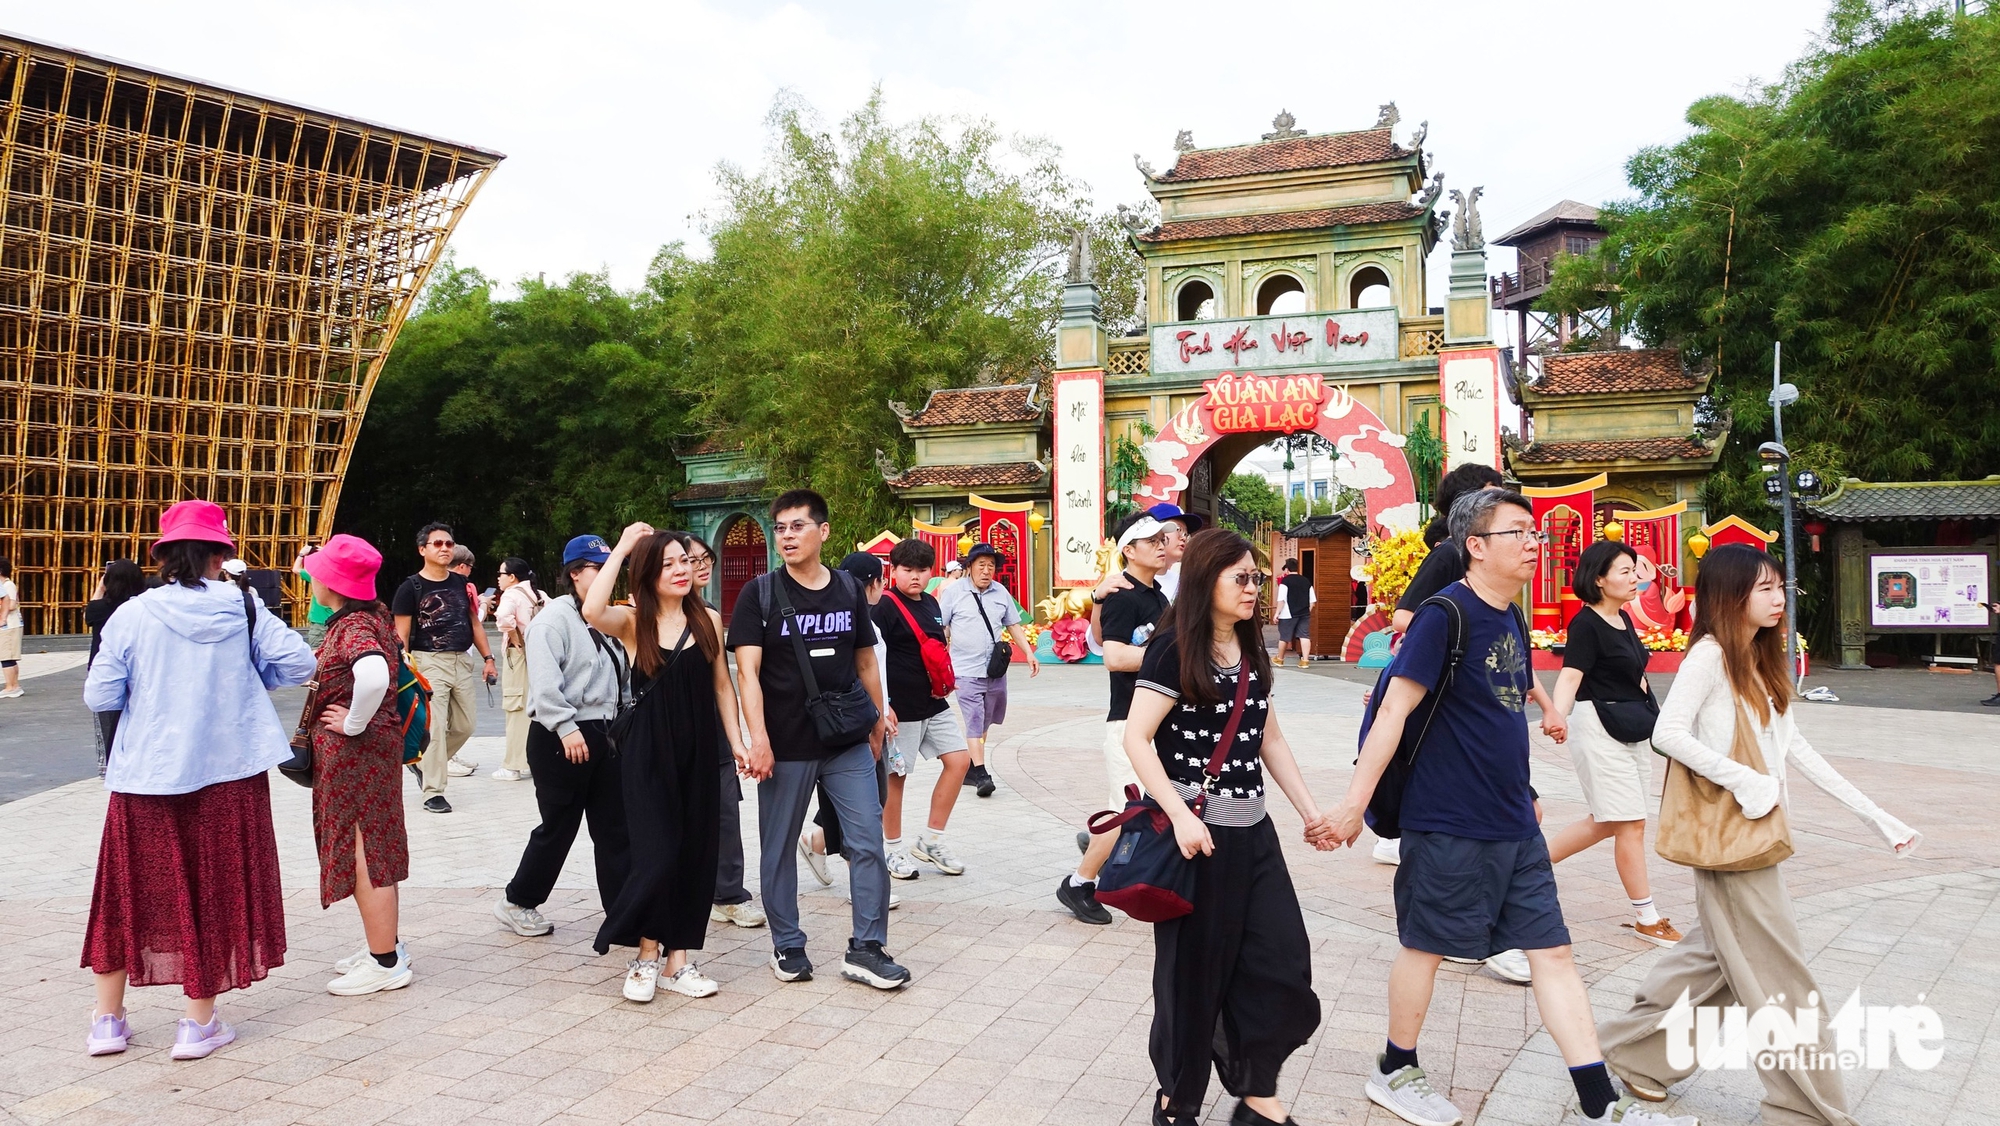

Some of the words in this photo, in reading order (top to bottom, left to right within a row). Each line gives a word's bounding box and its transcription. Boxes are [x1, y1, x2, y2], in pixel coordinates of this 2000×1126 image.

[1271, 321, 1312, 354] Việt
[1326, 318, 1369, 351] Nam
[1205, 374, 1280, 406] XUÂN
[1282, 377, 1321, 402] AN
[1454, 380, 1484, 400] Phúc
[1213, 405, 1260, 431] GIA
[1264, 402, 1315, 431] LẠC
[1066, 490, 1092, 509] Thành
[1066, 536, 1093, 564] Công
